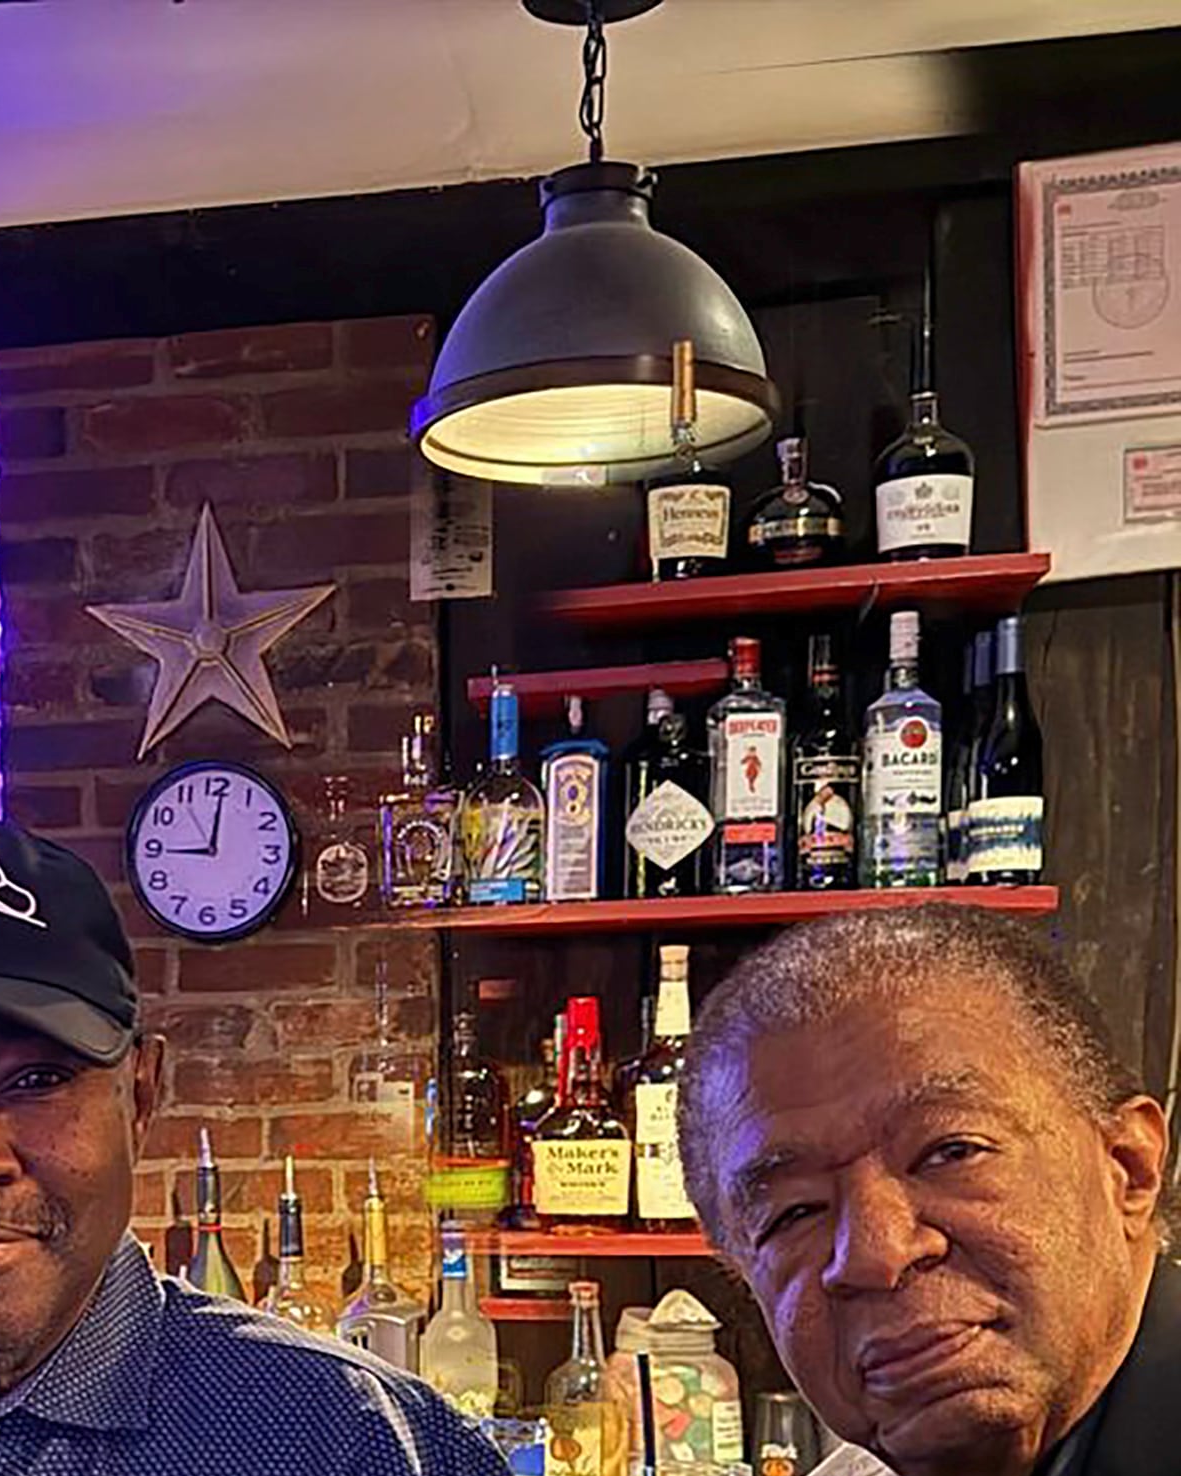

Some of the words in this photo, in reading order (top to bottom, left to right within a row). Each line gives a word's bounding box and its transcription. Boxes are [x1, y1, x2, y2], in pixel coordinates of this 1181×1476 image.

[882, 752, 938, 767] BACARD
[178, 785, 194, 803] 11
[205, 777, 231, 797] 12
[246, 788, 253, 807] 1
[153, 806, 175, 826] 10
[258, 812, 278, 831] 2
[145, 839, 164, 858] 9
[262, 844, 282, 864] 3
[148, 870, 169, 891] 8
[253, 876, 271, 896] 4
[170, 895, 189, 915] 7
[229, 899, 248, 918] 5
[198, 906, 217, 926] 6
[546, 1145, 620, 1160] Maker's
[565, 1161, 619, 1175] Mark
